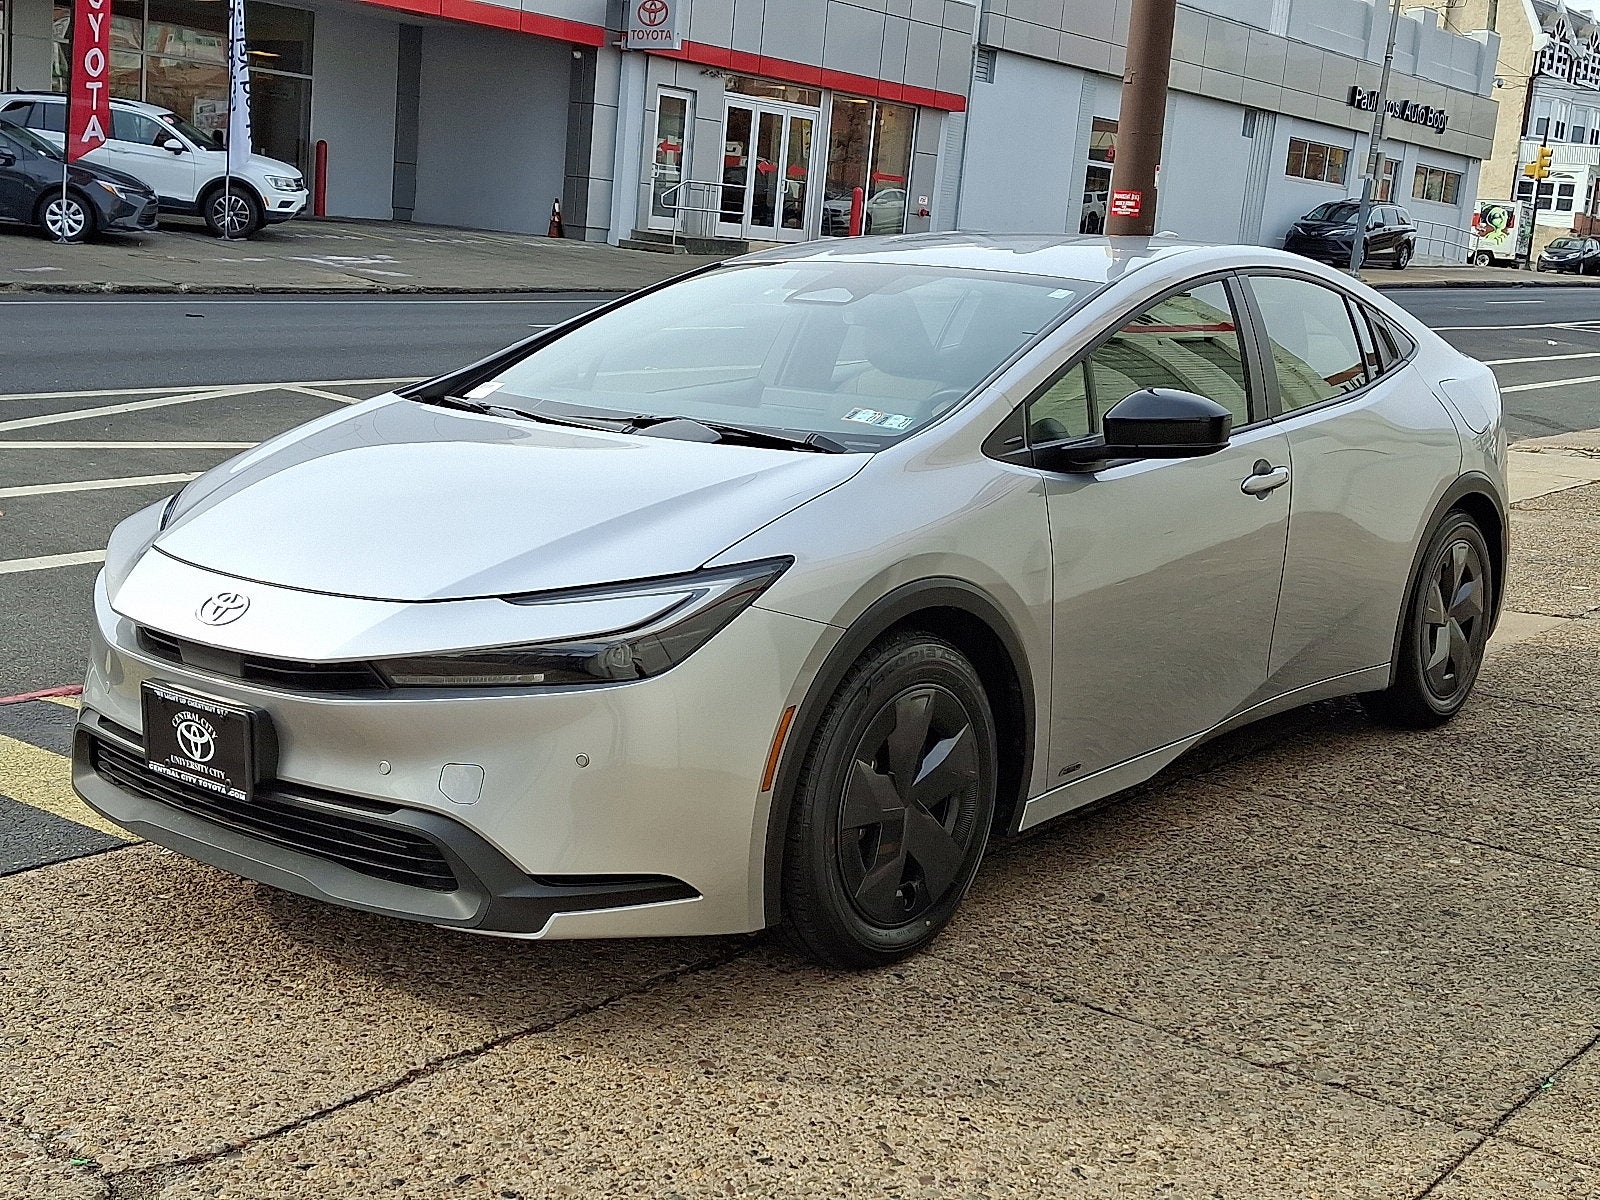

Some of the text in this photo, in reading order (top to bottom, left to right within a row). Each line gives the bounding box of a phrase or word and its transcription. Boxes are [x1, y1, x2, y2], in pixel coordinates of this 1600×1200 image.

[630, 29, 672, 41] TOYOTA
[1353, 86, 1379, 112] Paul
[1383, 99, 1402, 119] ros.
[1403, 99, 1427, 124] Auto
[171, 710, 219, 739] CENTRAL CITY
[148, 763, 180, 779] CENTRAL
[180, 773, 198, 784] CITY
[197, 779, 227, 795] TOYOTA
[170, 754, 226, 780] UNIVERSITY CITY
